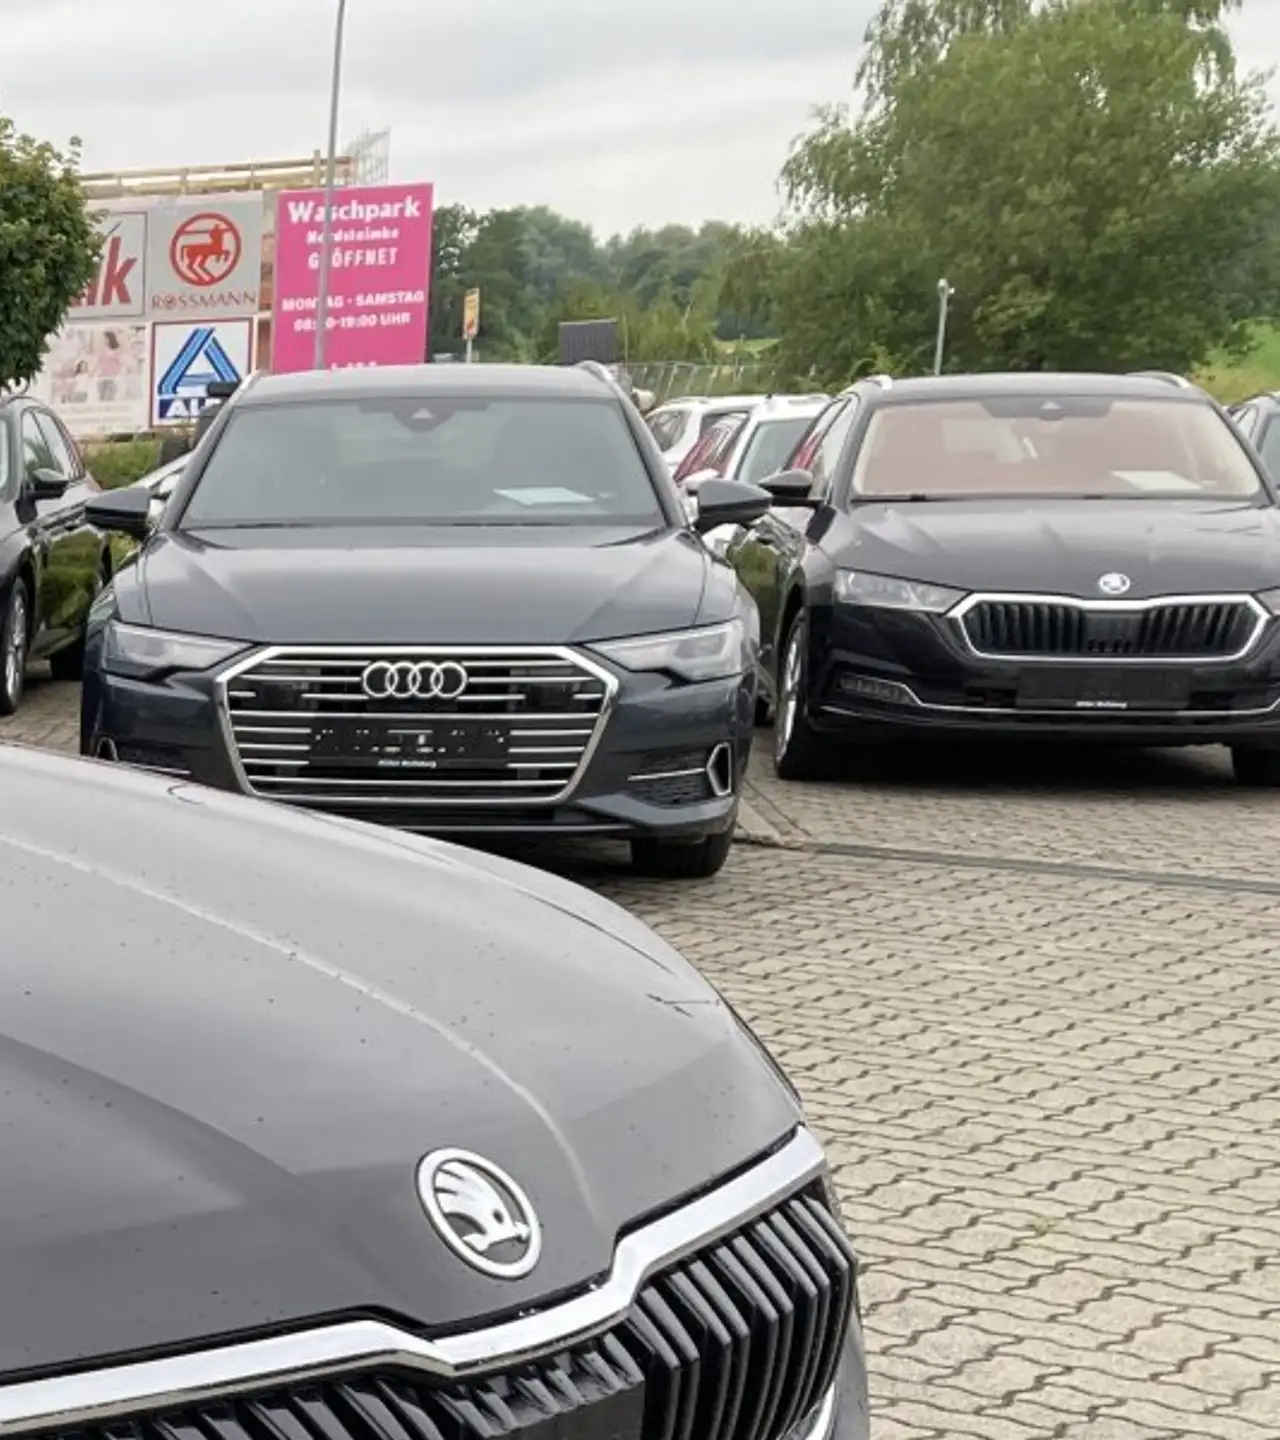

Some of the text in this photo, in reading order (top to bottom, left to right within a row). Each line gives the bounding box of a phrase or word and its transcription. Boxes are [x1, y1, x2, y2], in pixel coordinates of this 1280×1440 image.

[307, 247, 398, 270] GÖFFNET
[151, 290, 257, 311] ROSSMANN
[355, 290, 425, 307] SAMSTAG
[293, 312, 411, 332] 08:0-19:00 UHR
